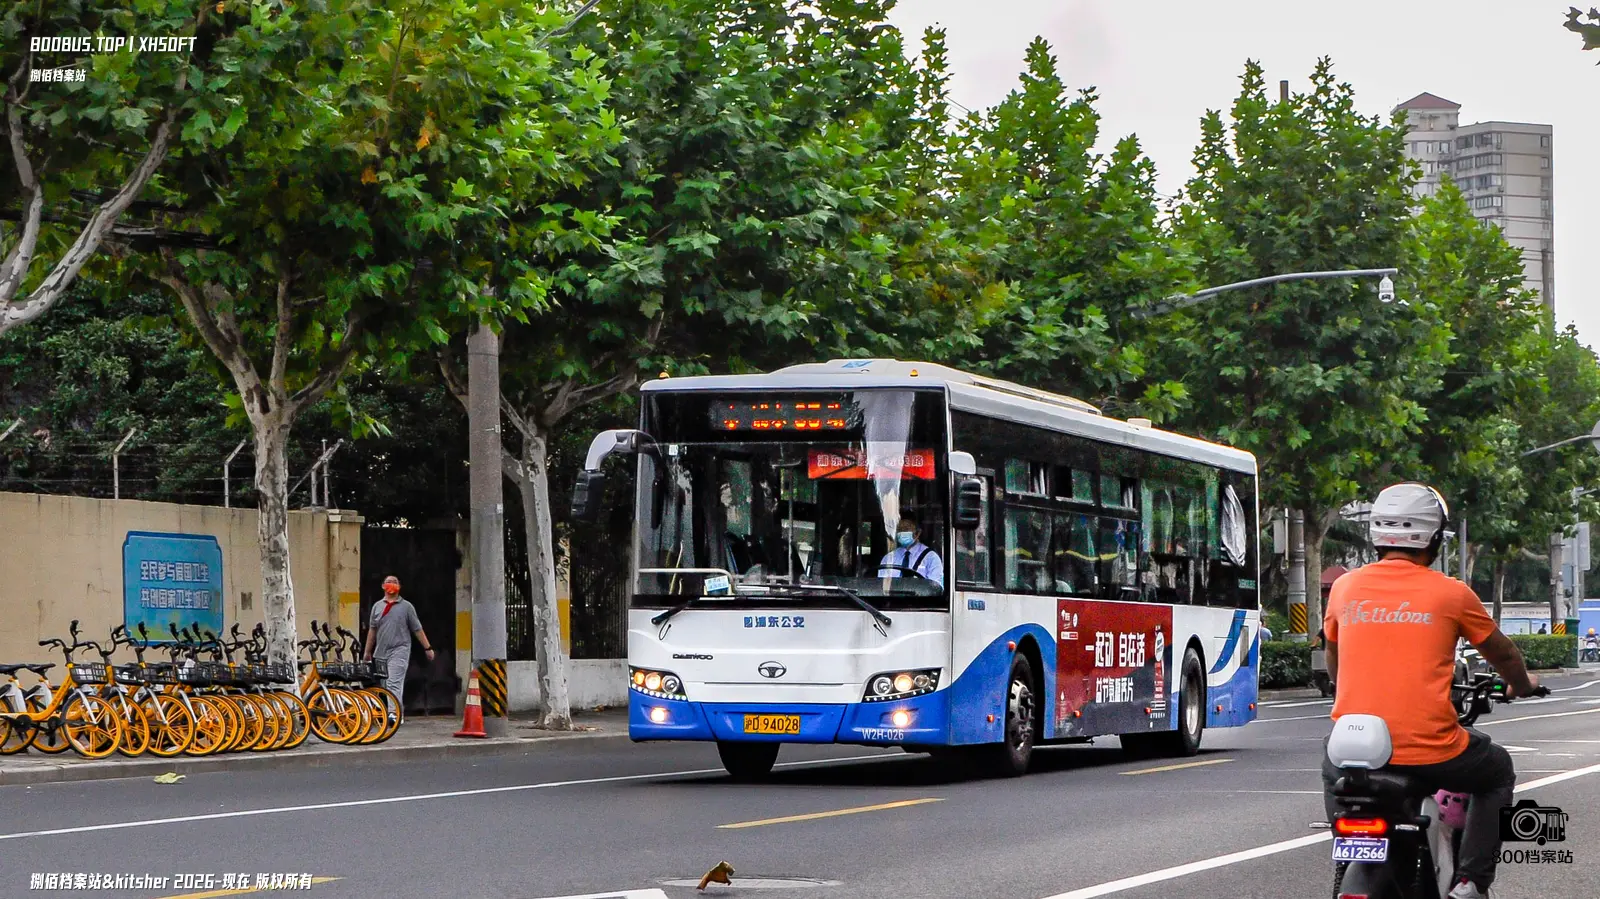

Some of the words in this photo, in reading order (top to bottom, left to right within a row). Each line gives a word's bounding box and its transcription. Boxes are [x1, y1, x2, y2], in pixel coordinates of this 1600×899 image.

[140, 560, 209, 582] 全民参与爱国卫生
[755, 616, 805, 628] 浦东公交
[861, 728, 905, 741] W2H-026
[1334, 846, 1385, 859] A612566
